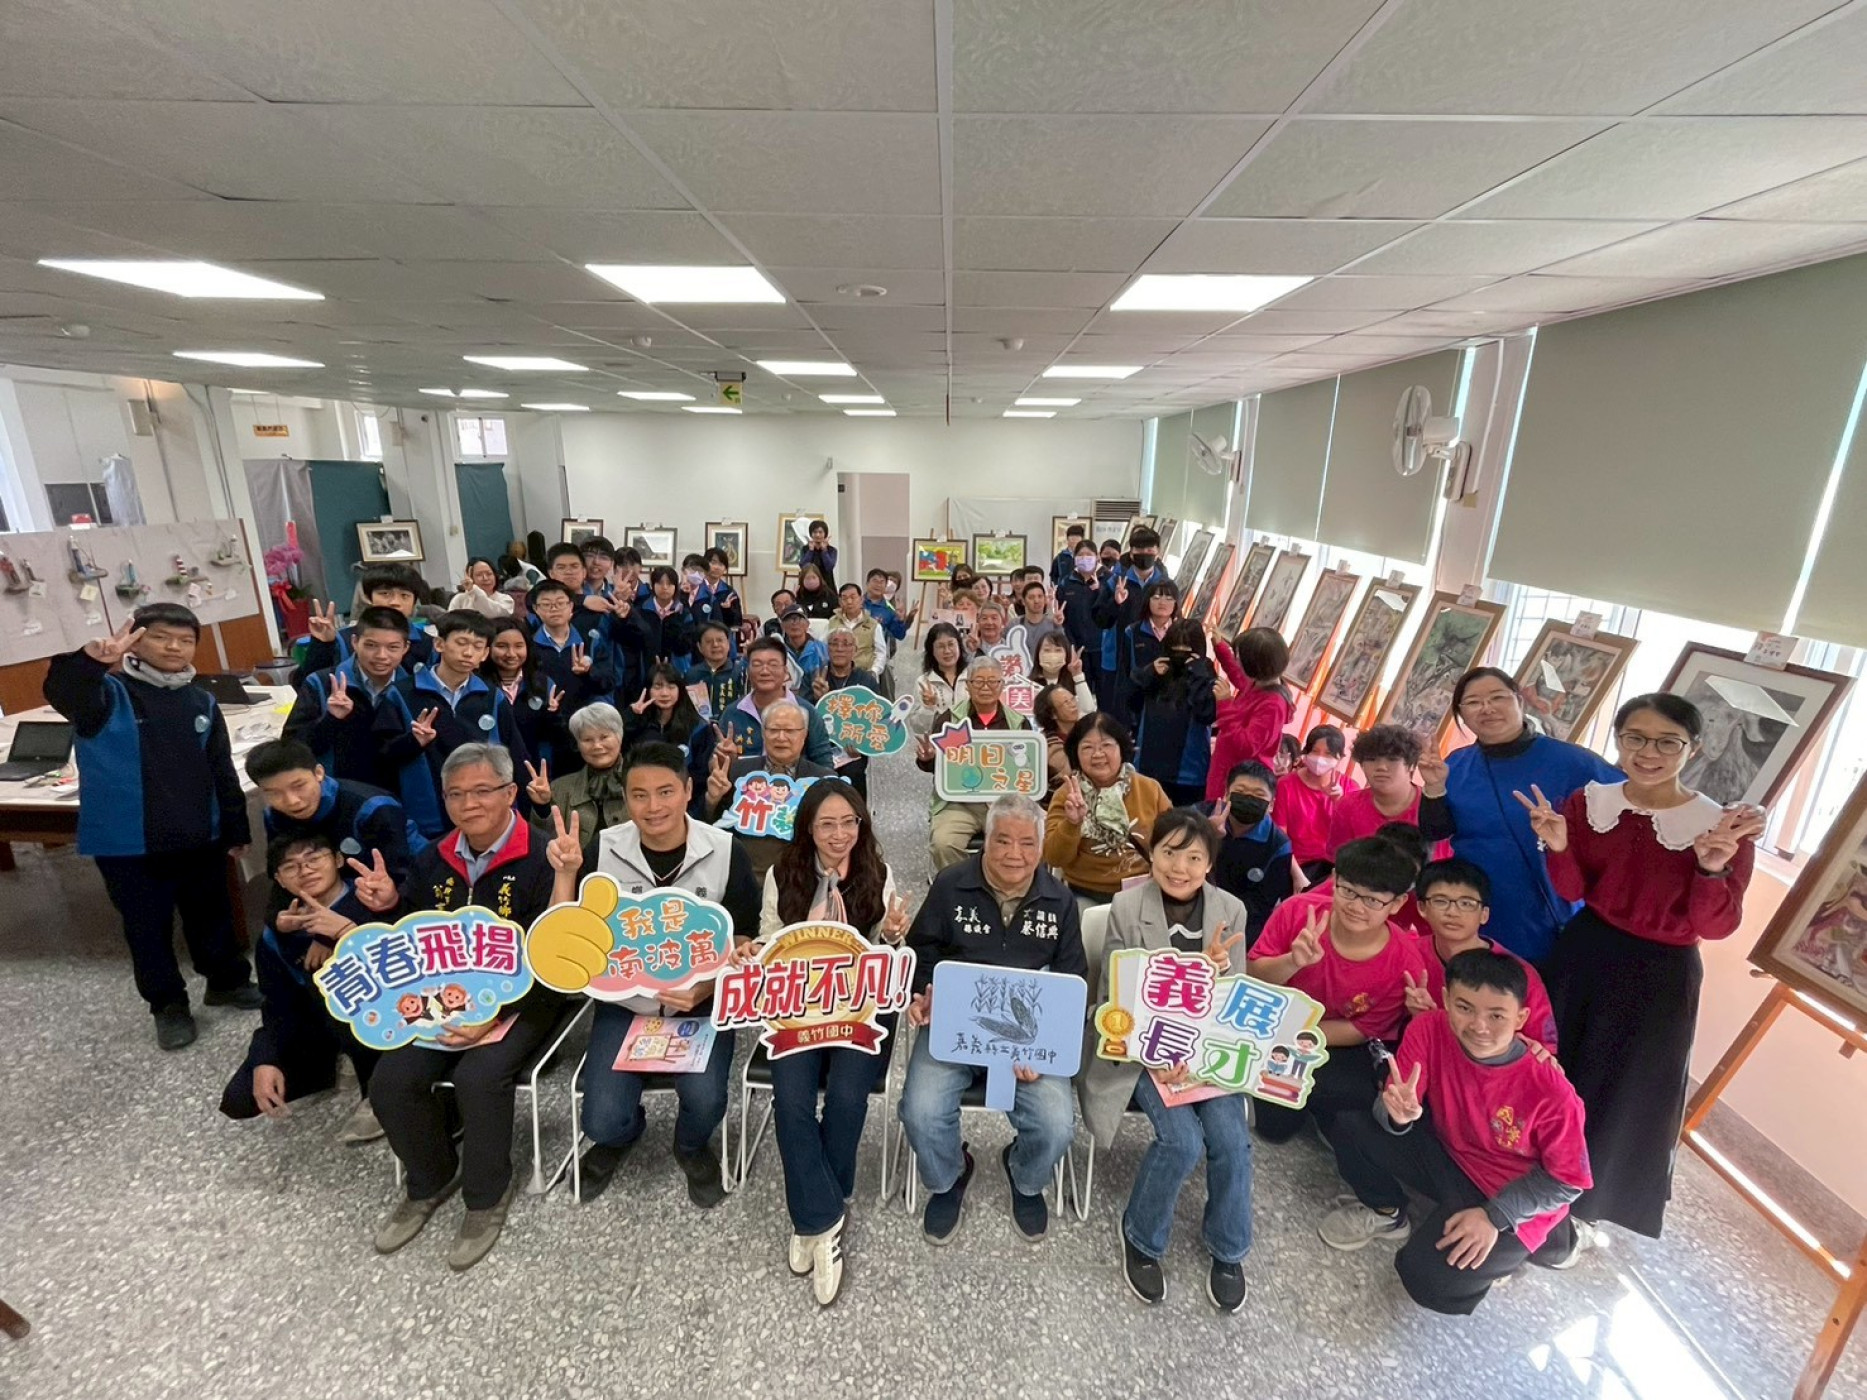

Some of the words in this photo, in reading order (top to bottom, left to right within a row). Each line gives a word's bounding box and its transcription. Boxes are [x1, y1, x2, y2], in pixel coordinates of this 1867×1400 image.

[826, 695, 884, 723] 擇你
[840, 722, 889, 750] 所愛
[946, 744, 1004, 767] 明日
[991, 767, 1034, 794] 之星
[618, 900, 688, 939] 我是
[319, 921, 520, 1014] 青春飛揚
[608, 930, 719, 979] 南波萬
[797, 1026, 854, 1043] 義竹國中
